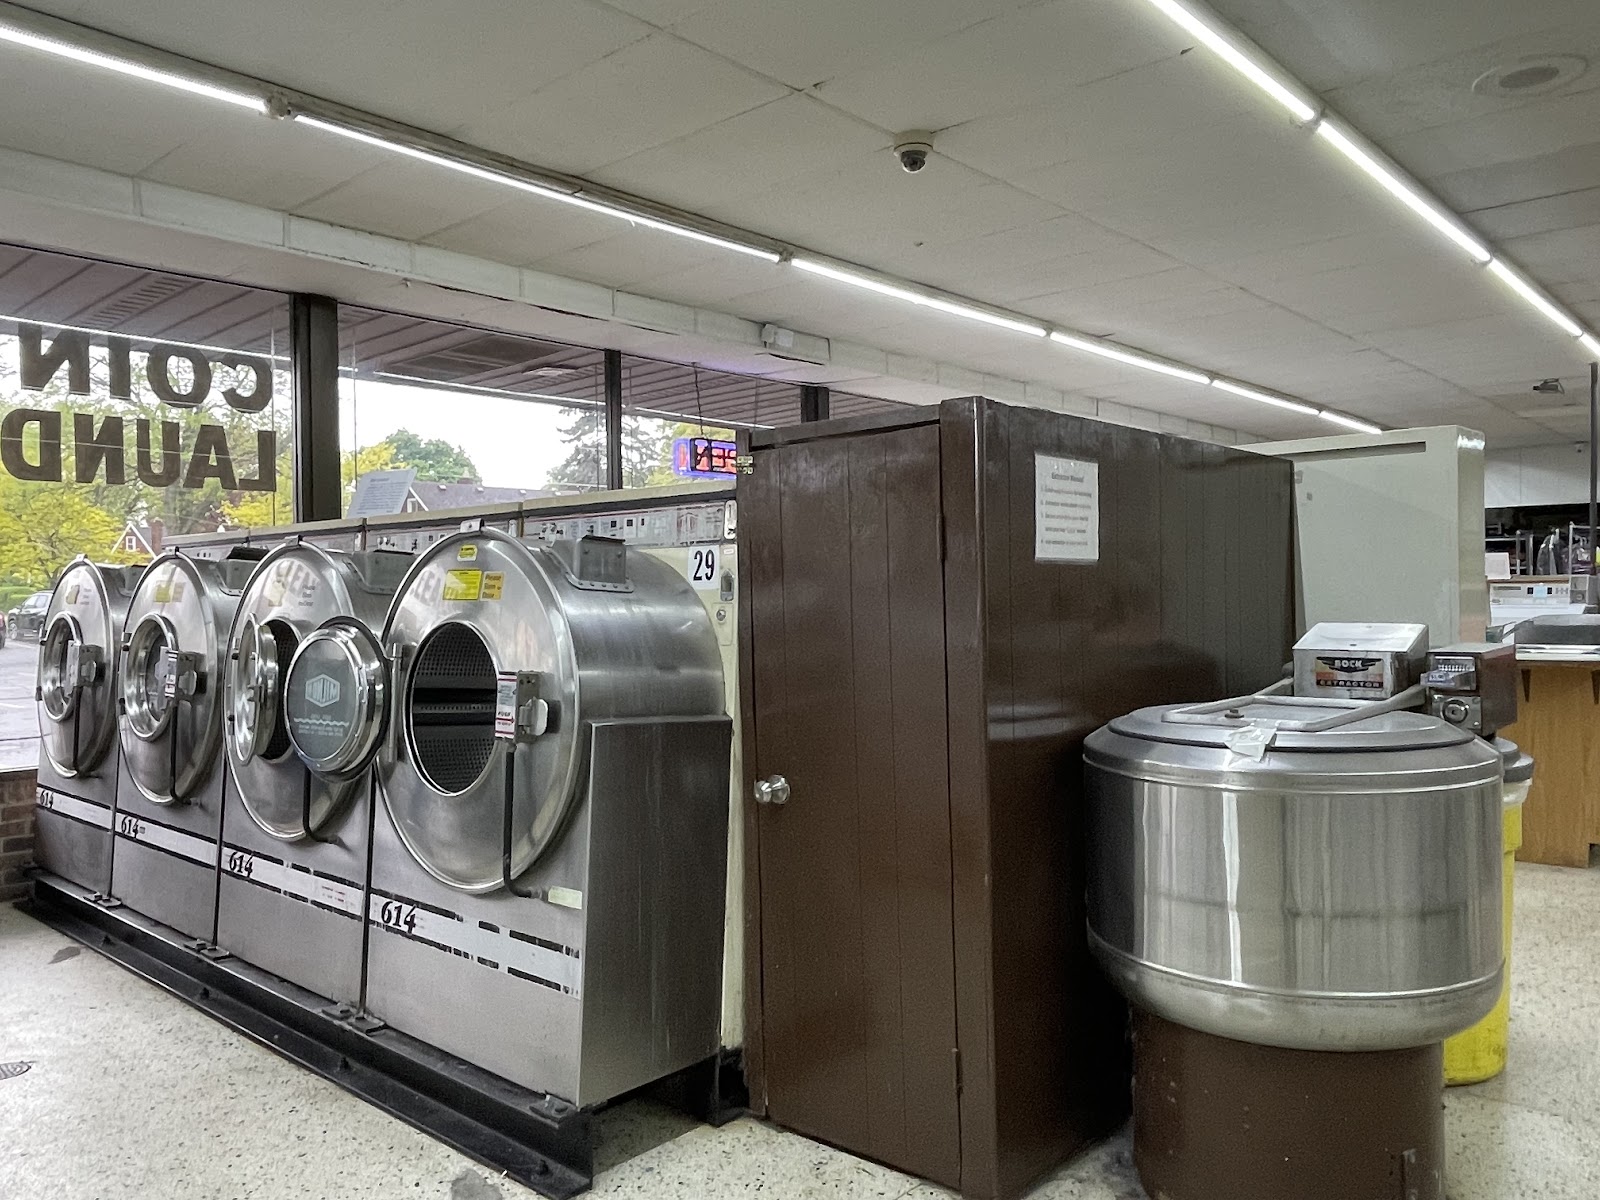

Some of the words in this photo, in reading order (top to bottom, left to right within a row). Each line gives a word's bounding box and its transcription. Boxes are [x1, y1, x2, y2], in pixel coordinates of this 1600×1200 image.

[692, 549, 715, 581] 29
[1334, 660, 1363, 668] BOCK
[121, 815, 140, 839] 614
[228, 851, 254, 878] 614
[381, 901, 417, 934] 614
